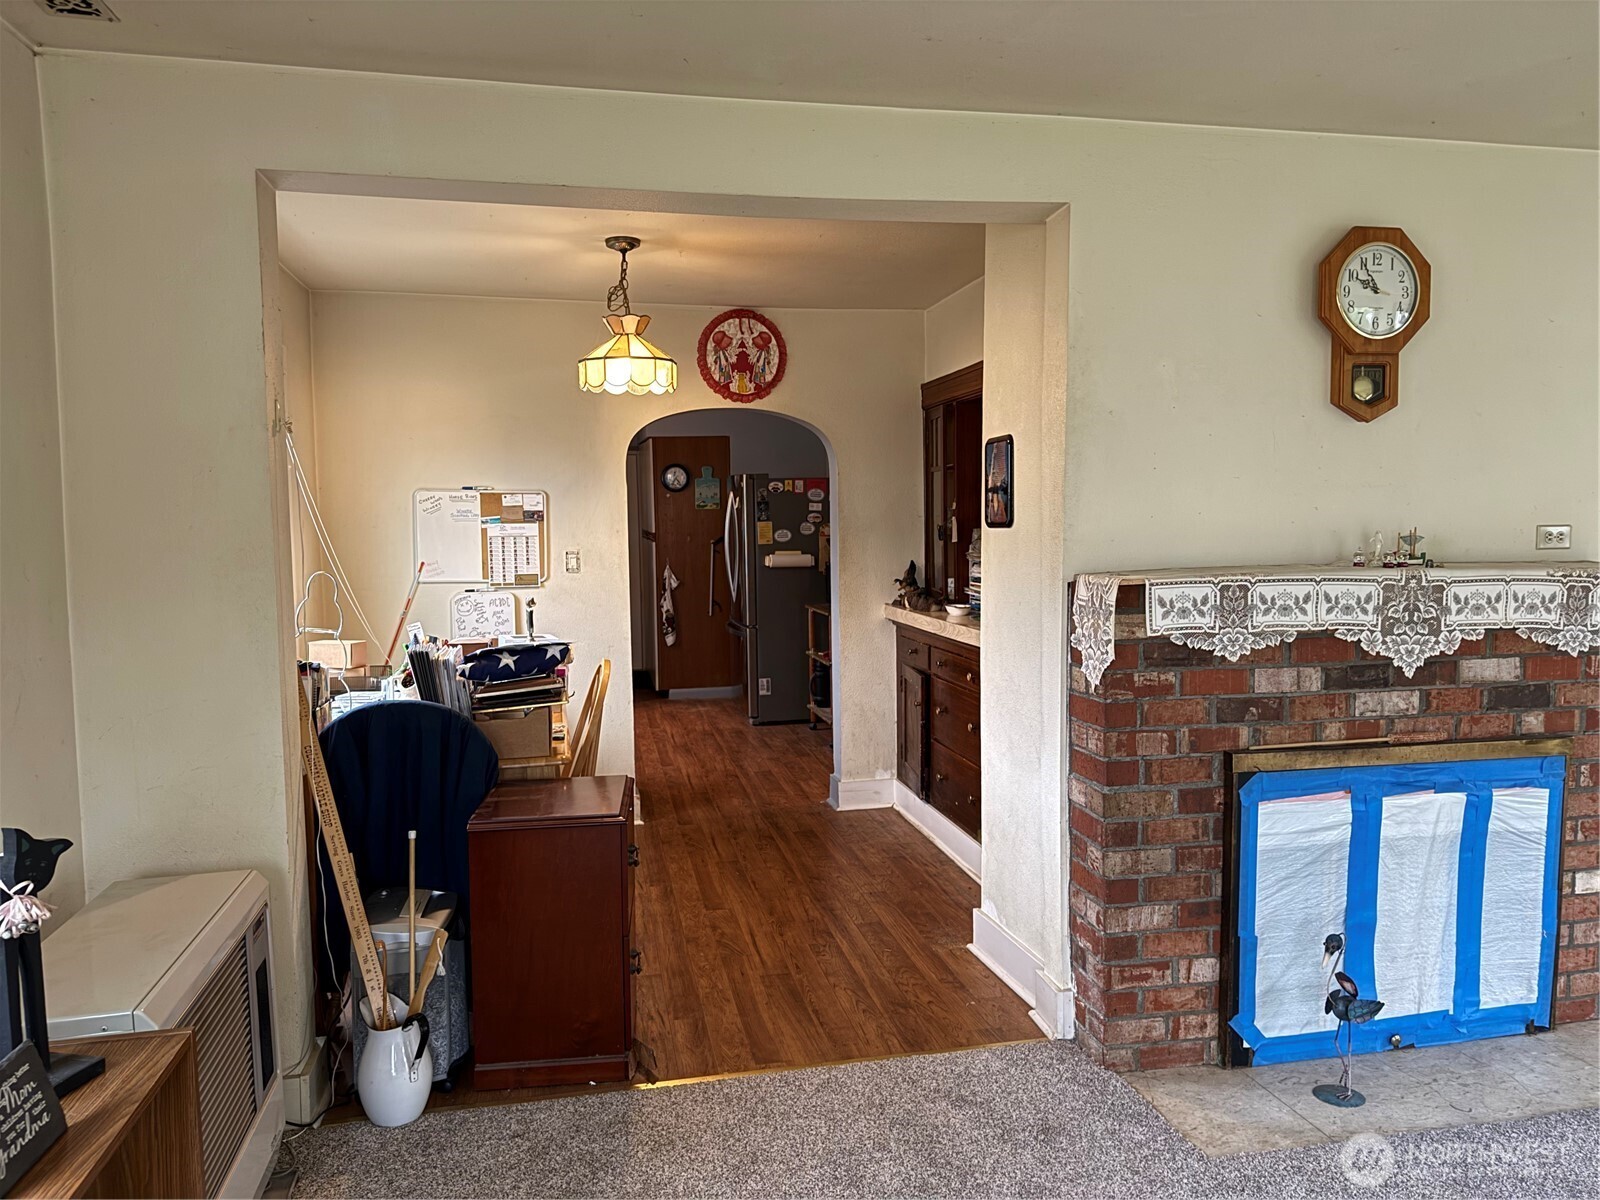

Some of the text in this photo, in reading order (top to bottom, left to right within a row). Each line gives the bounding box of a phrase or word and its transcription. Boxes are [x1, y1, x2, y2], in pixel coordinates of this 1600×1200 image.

[1372, 252, 1383, 266] 12
[1391, 257, 1395, 271] 1
[1348, 268, 1359, 283] 10
[1398, 270, 1406, 284] 2
[1343, 285, 1350, 298] 9
[1402, 286, 1409, 299] 3
[1347, 300, 1355, 314] 8
[1396, 301, 1404, 315] 4
[1357, 311, 1365, 326] 7
[1372, 316, 1380, 330] 6
[1386, 313, 1394, 327] 5
[315, 782, 328, 807] MAPLE
[321, 807, 333, 828] SHOP
[330, 835, 339, 857] Serving
[341, 880, 351, 902] Harbor
[354, 925, 363, 941] 1903
[0, 1080, 38, 1114] Mom
